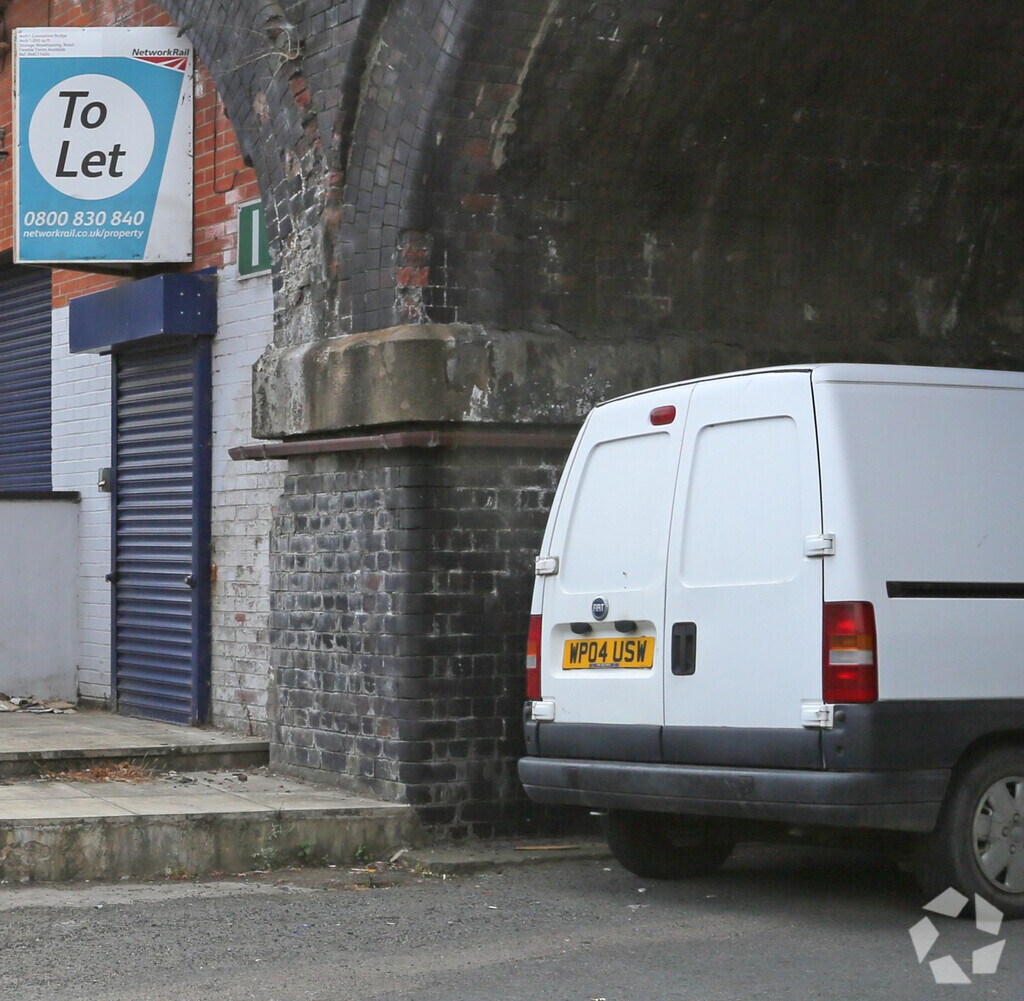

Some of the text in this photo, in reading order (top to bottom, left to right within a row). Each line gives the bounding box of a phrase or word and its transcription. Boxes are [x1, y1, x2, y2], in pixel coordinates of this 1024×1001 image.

[59, 91, 107, 129] To
[56, 140, 126, 178] Let
[24, 210, 145, 226] 0800 830 840
[23, 229, 144, 239] networkrail.co.uk/property
[570, 640, 647, 664] WP04 USW
